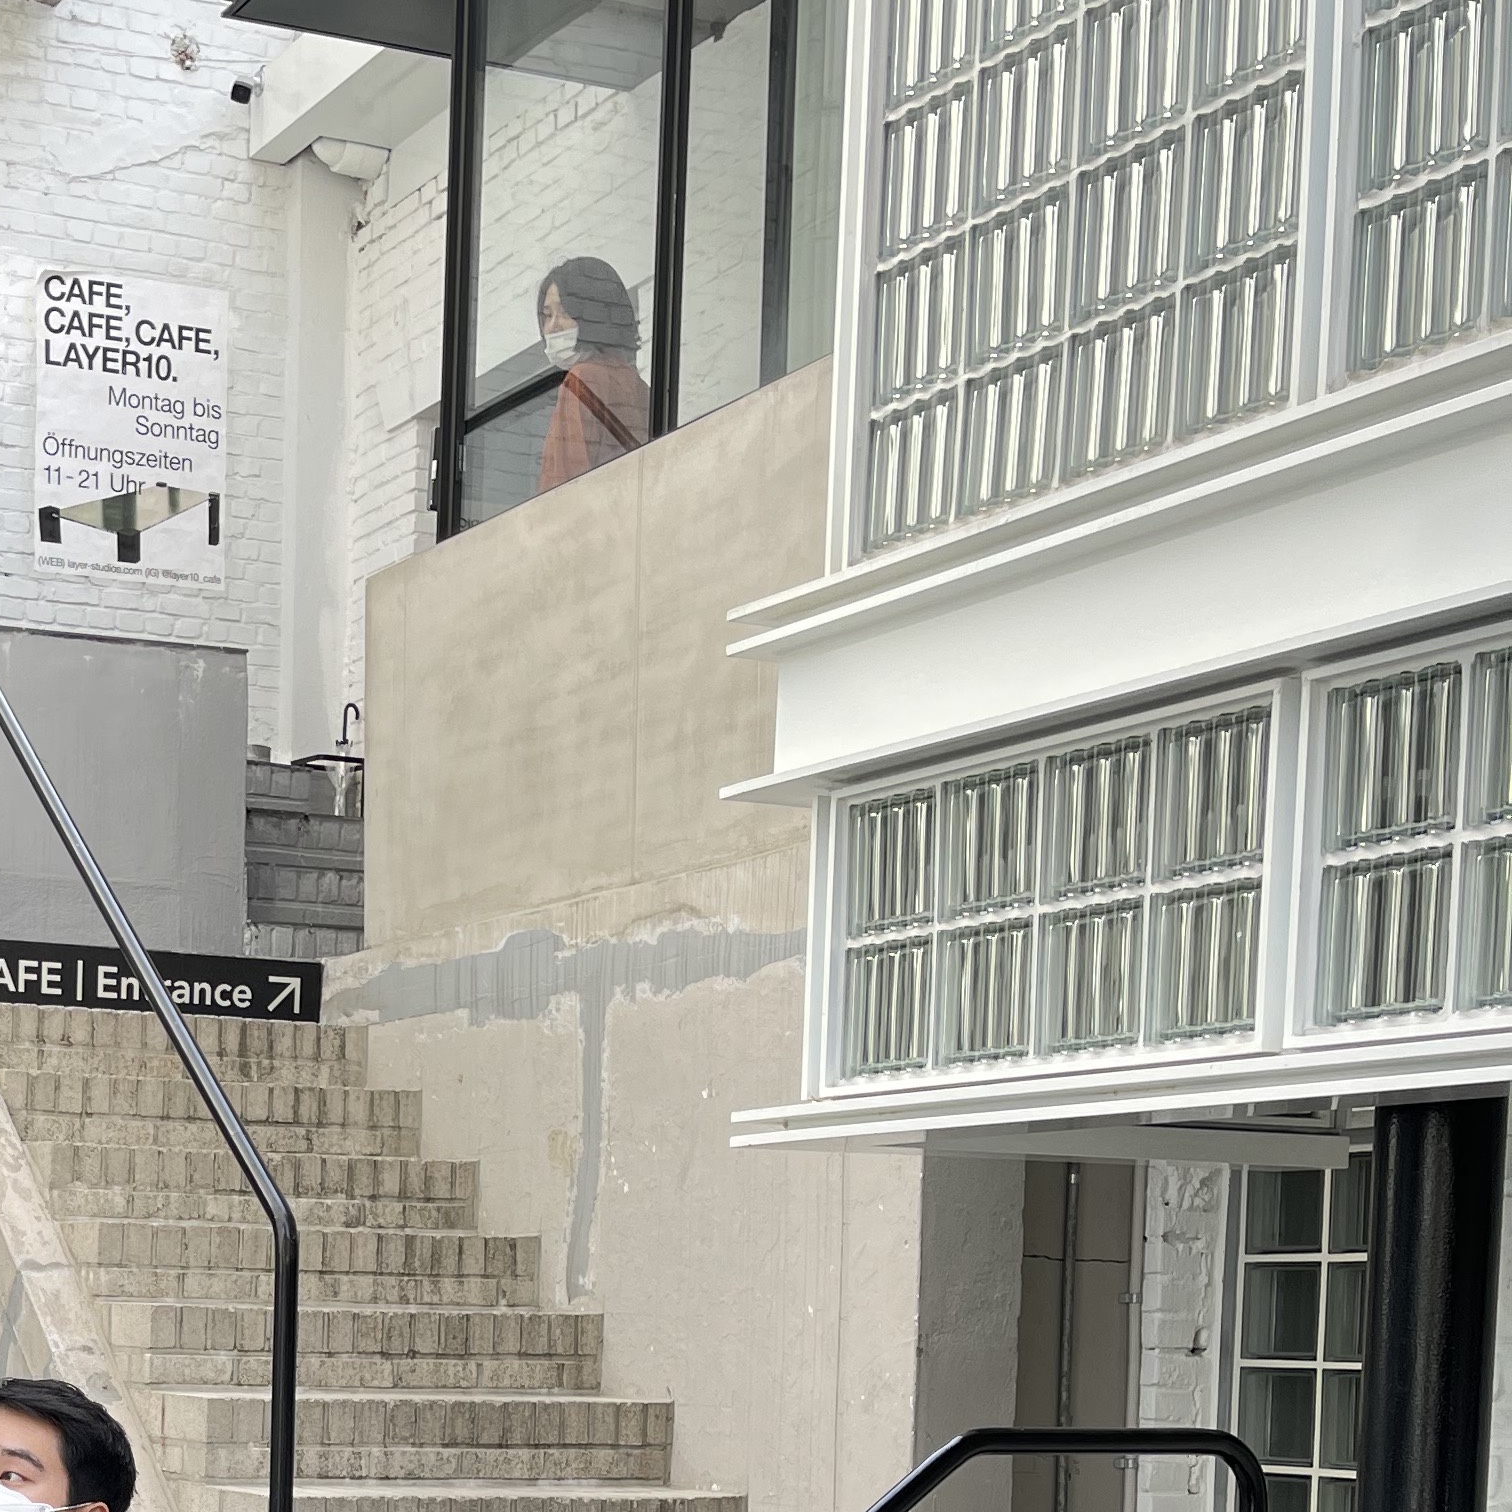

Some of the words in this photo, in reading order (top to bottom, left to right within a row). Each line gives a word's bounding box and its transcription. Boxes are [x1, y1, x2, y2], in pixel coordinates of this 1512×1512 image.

[44, 274, 131, 316] CAFE,
[44, 306, 130, 348] CAFE,
[135, 319, 219, 361] CAFE,
[44, 339, 178, 382] LAYER10.
[108, 385, 185, 420] Montag
[193, 397, 222, 419] bis
[135, 415, 219, 449] Sonntag
[43, 432, 193, 472] Öffnungszeiten
[110, 472, 146, 495] Uhr
[38, 556, 65, 569] (WEB)
